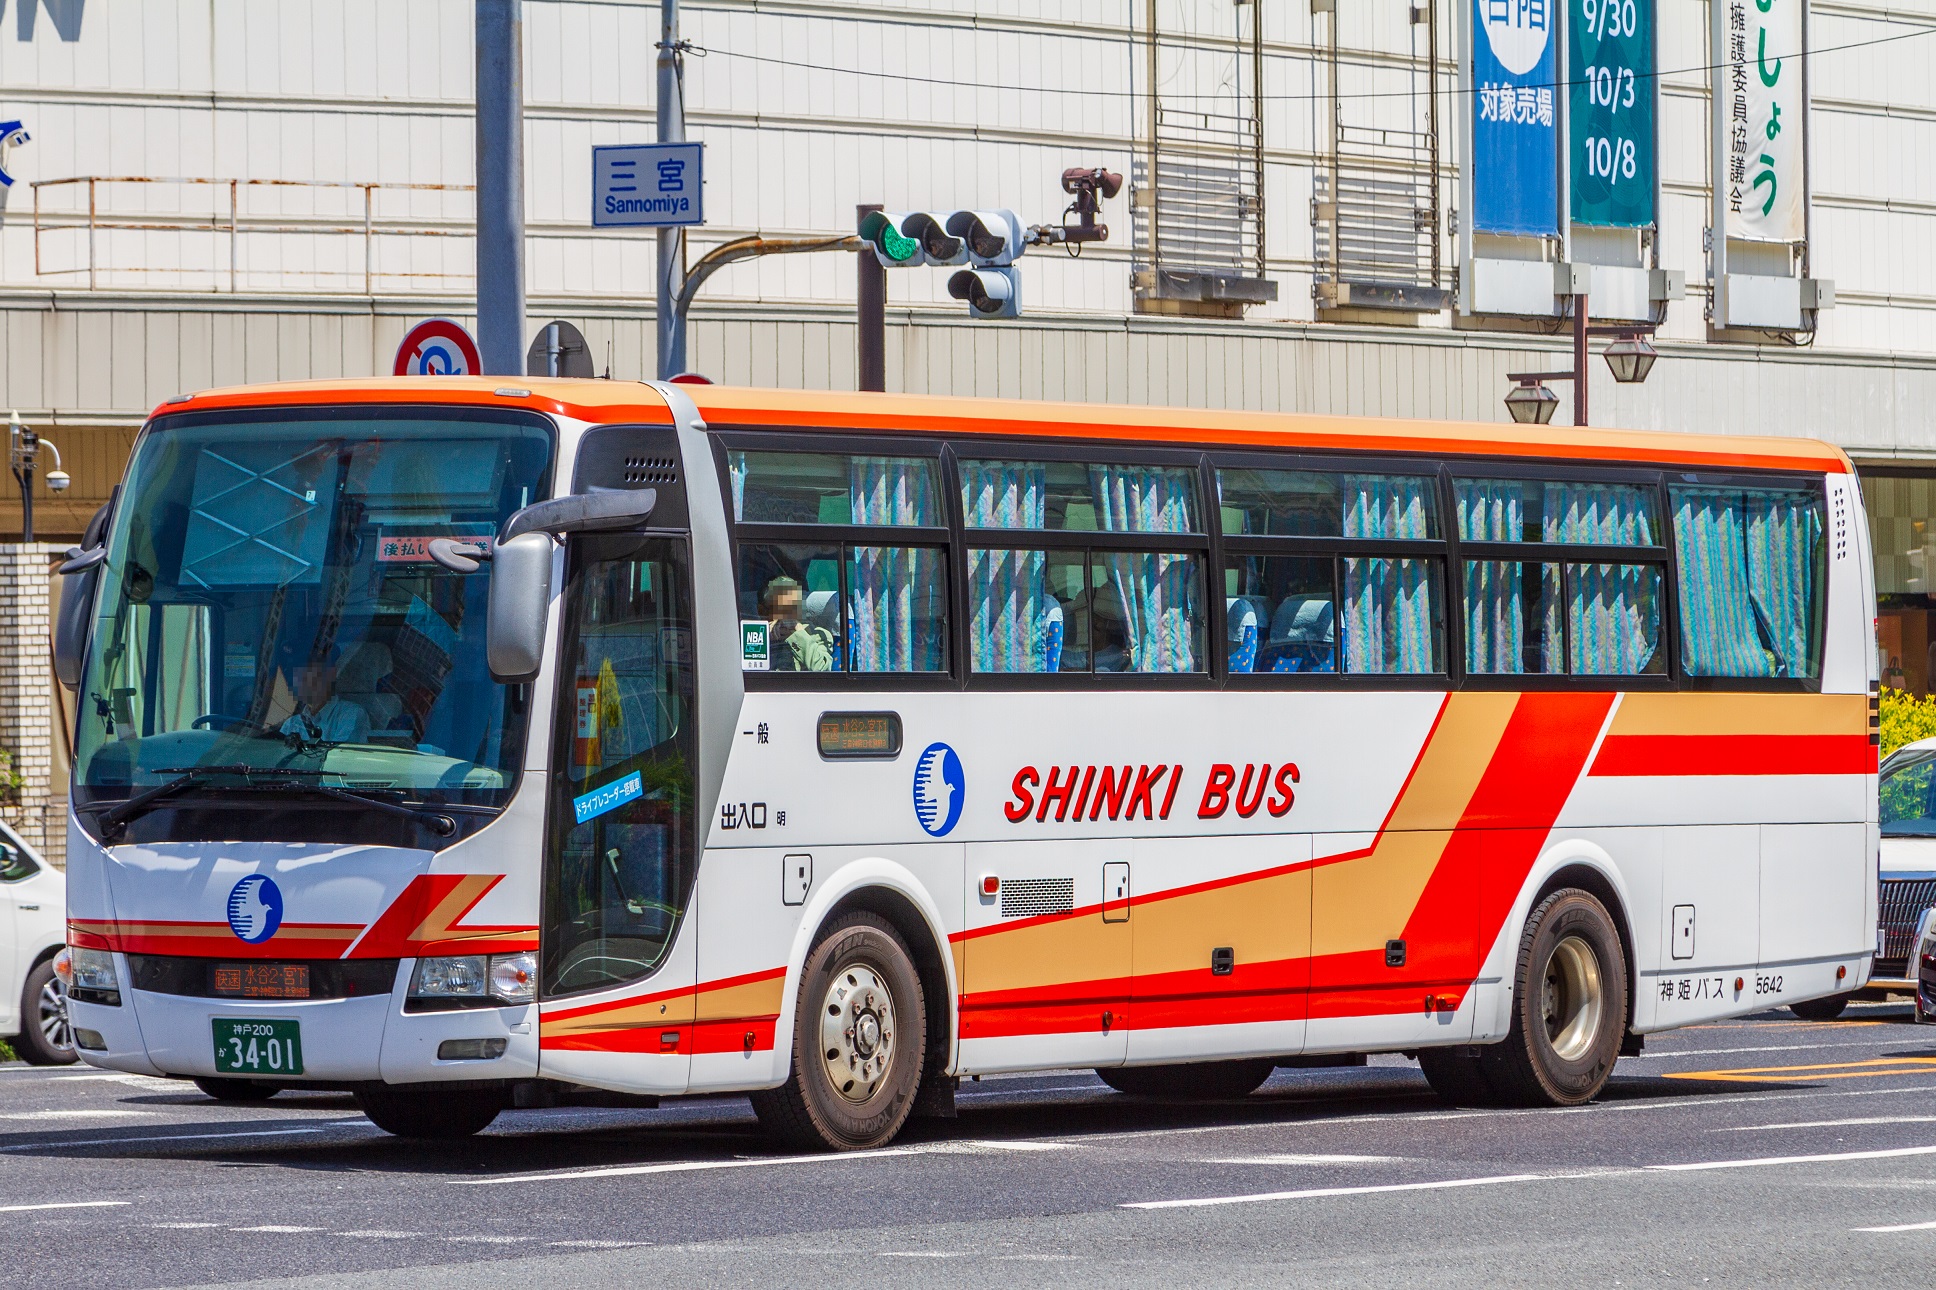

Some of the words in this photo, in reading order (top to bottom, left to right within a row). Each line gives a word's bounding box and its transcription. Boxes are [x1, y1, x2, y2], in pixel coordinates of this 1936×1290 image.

[1583, 0, 1636, 42] 9/30
[1480, 81, 1553, 127] 対象売場
[1585, 65, 1635, 114] 10/3
[609, 157, 685, 192] 三宮
[1585, 136, 1636, 185] 10/8
[605, 194, 689, 215] Sannomiya
[746, 631, 764, 643] NBA
[743, 722, 769, 744] 一般
[1003, 764, 1184, 823] SHINKI
[1197, 762, 1301, 820] BUS
[721, 802, 767, 830] 出入口
[1660, 978, 1724, 1001] 神姫バス
[1755, 975, 1783, 995] 5642
[228, 1037, 294, 1070] 34-01
